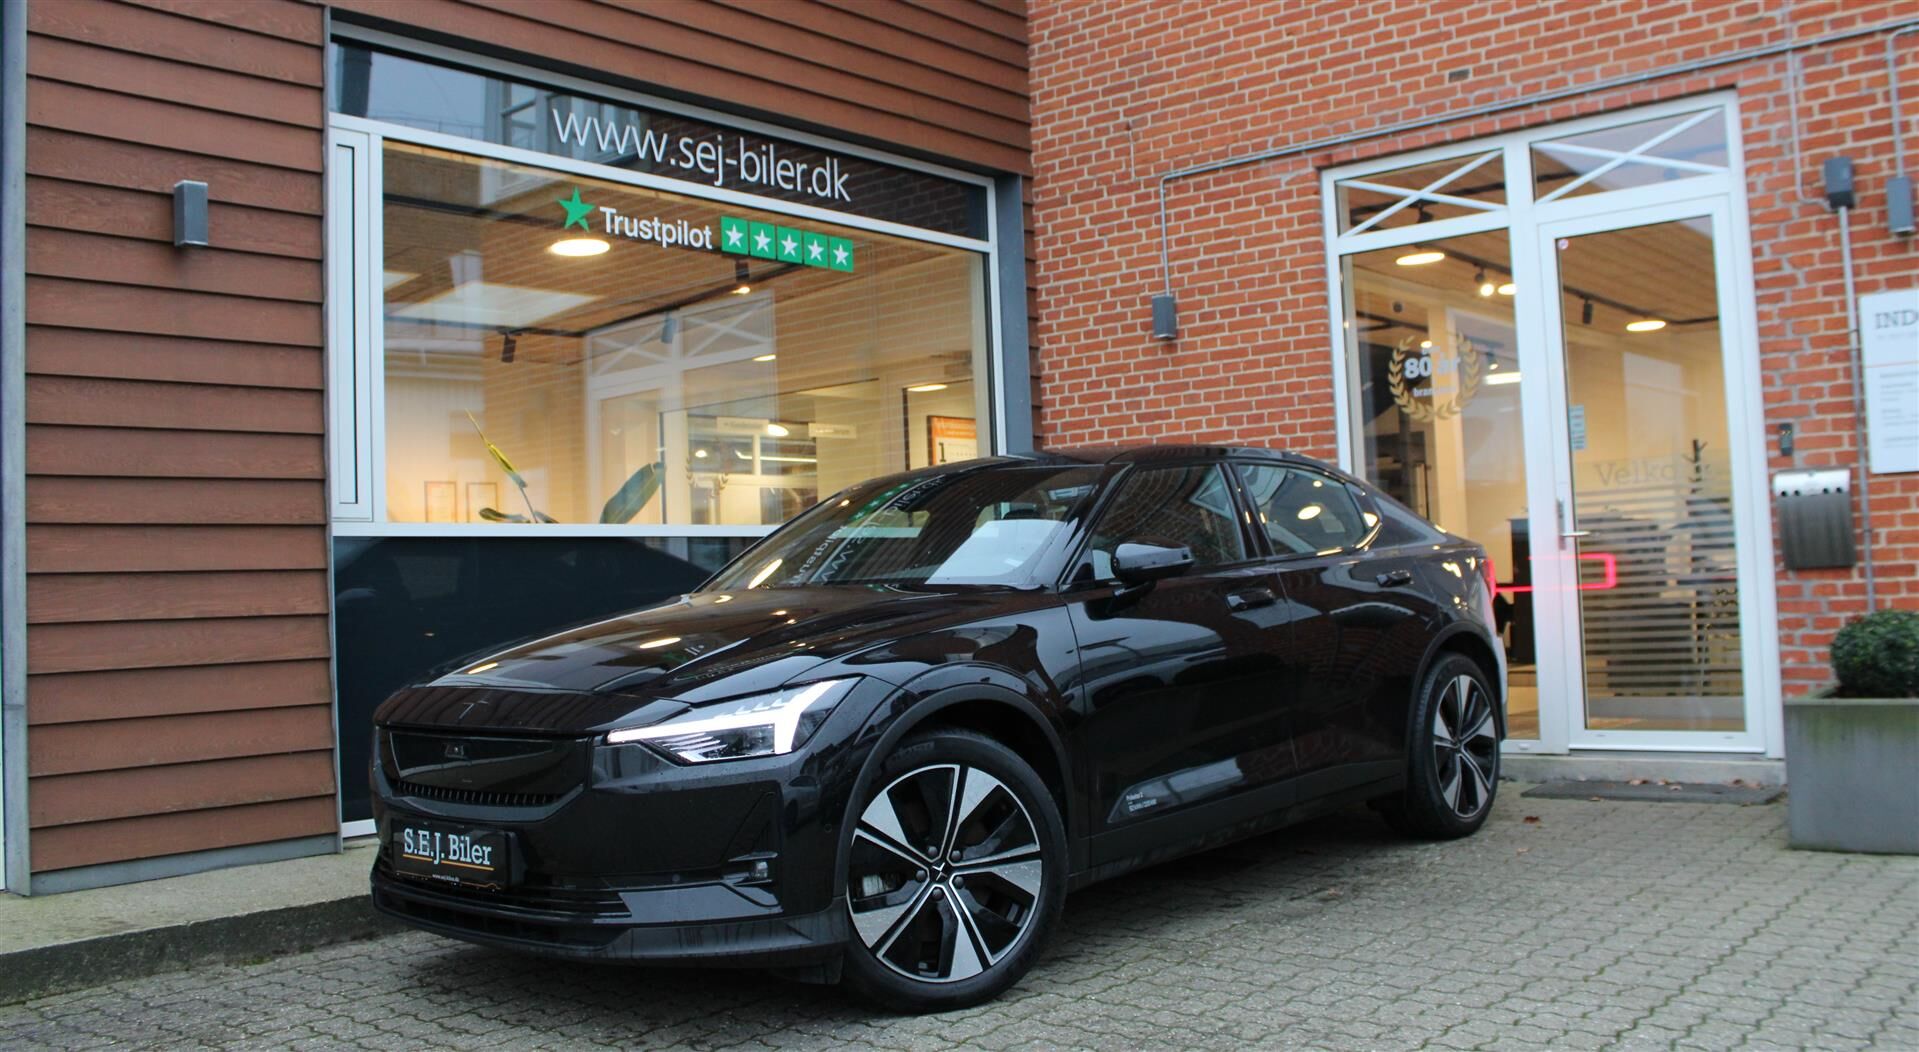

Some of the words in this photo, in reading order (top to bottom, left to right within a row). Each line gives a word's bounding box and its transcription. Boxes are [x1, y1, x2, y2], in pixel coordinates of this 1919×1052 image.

[552, 108, 851, 202] www.sej-biler.dk
[599, 206, 713, 249] Trustpilot
[1403, 356, 1432, 379] 80
[403, 827, 445, 865] S.E.J.
[448, 833, 492, 866] Biler
